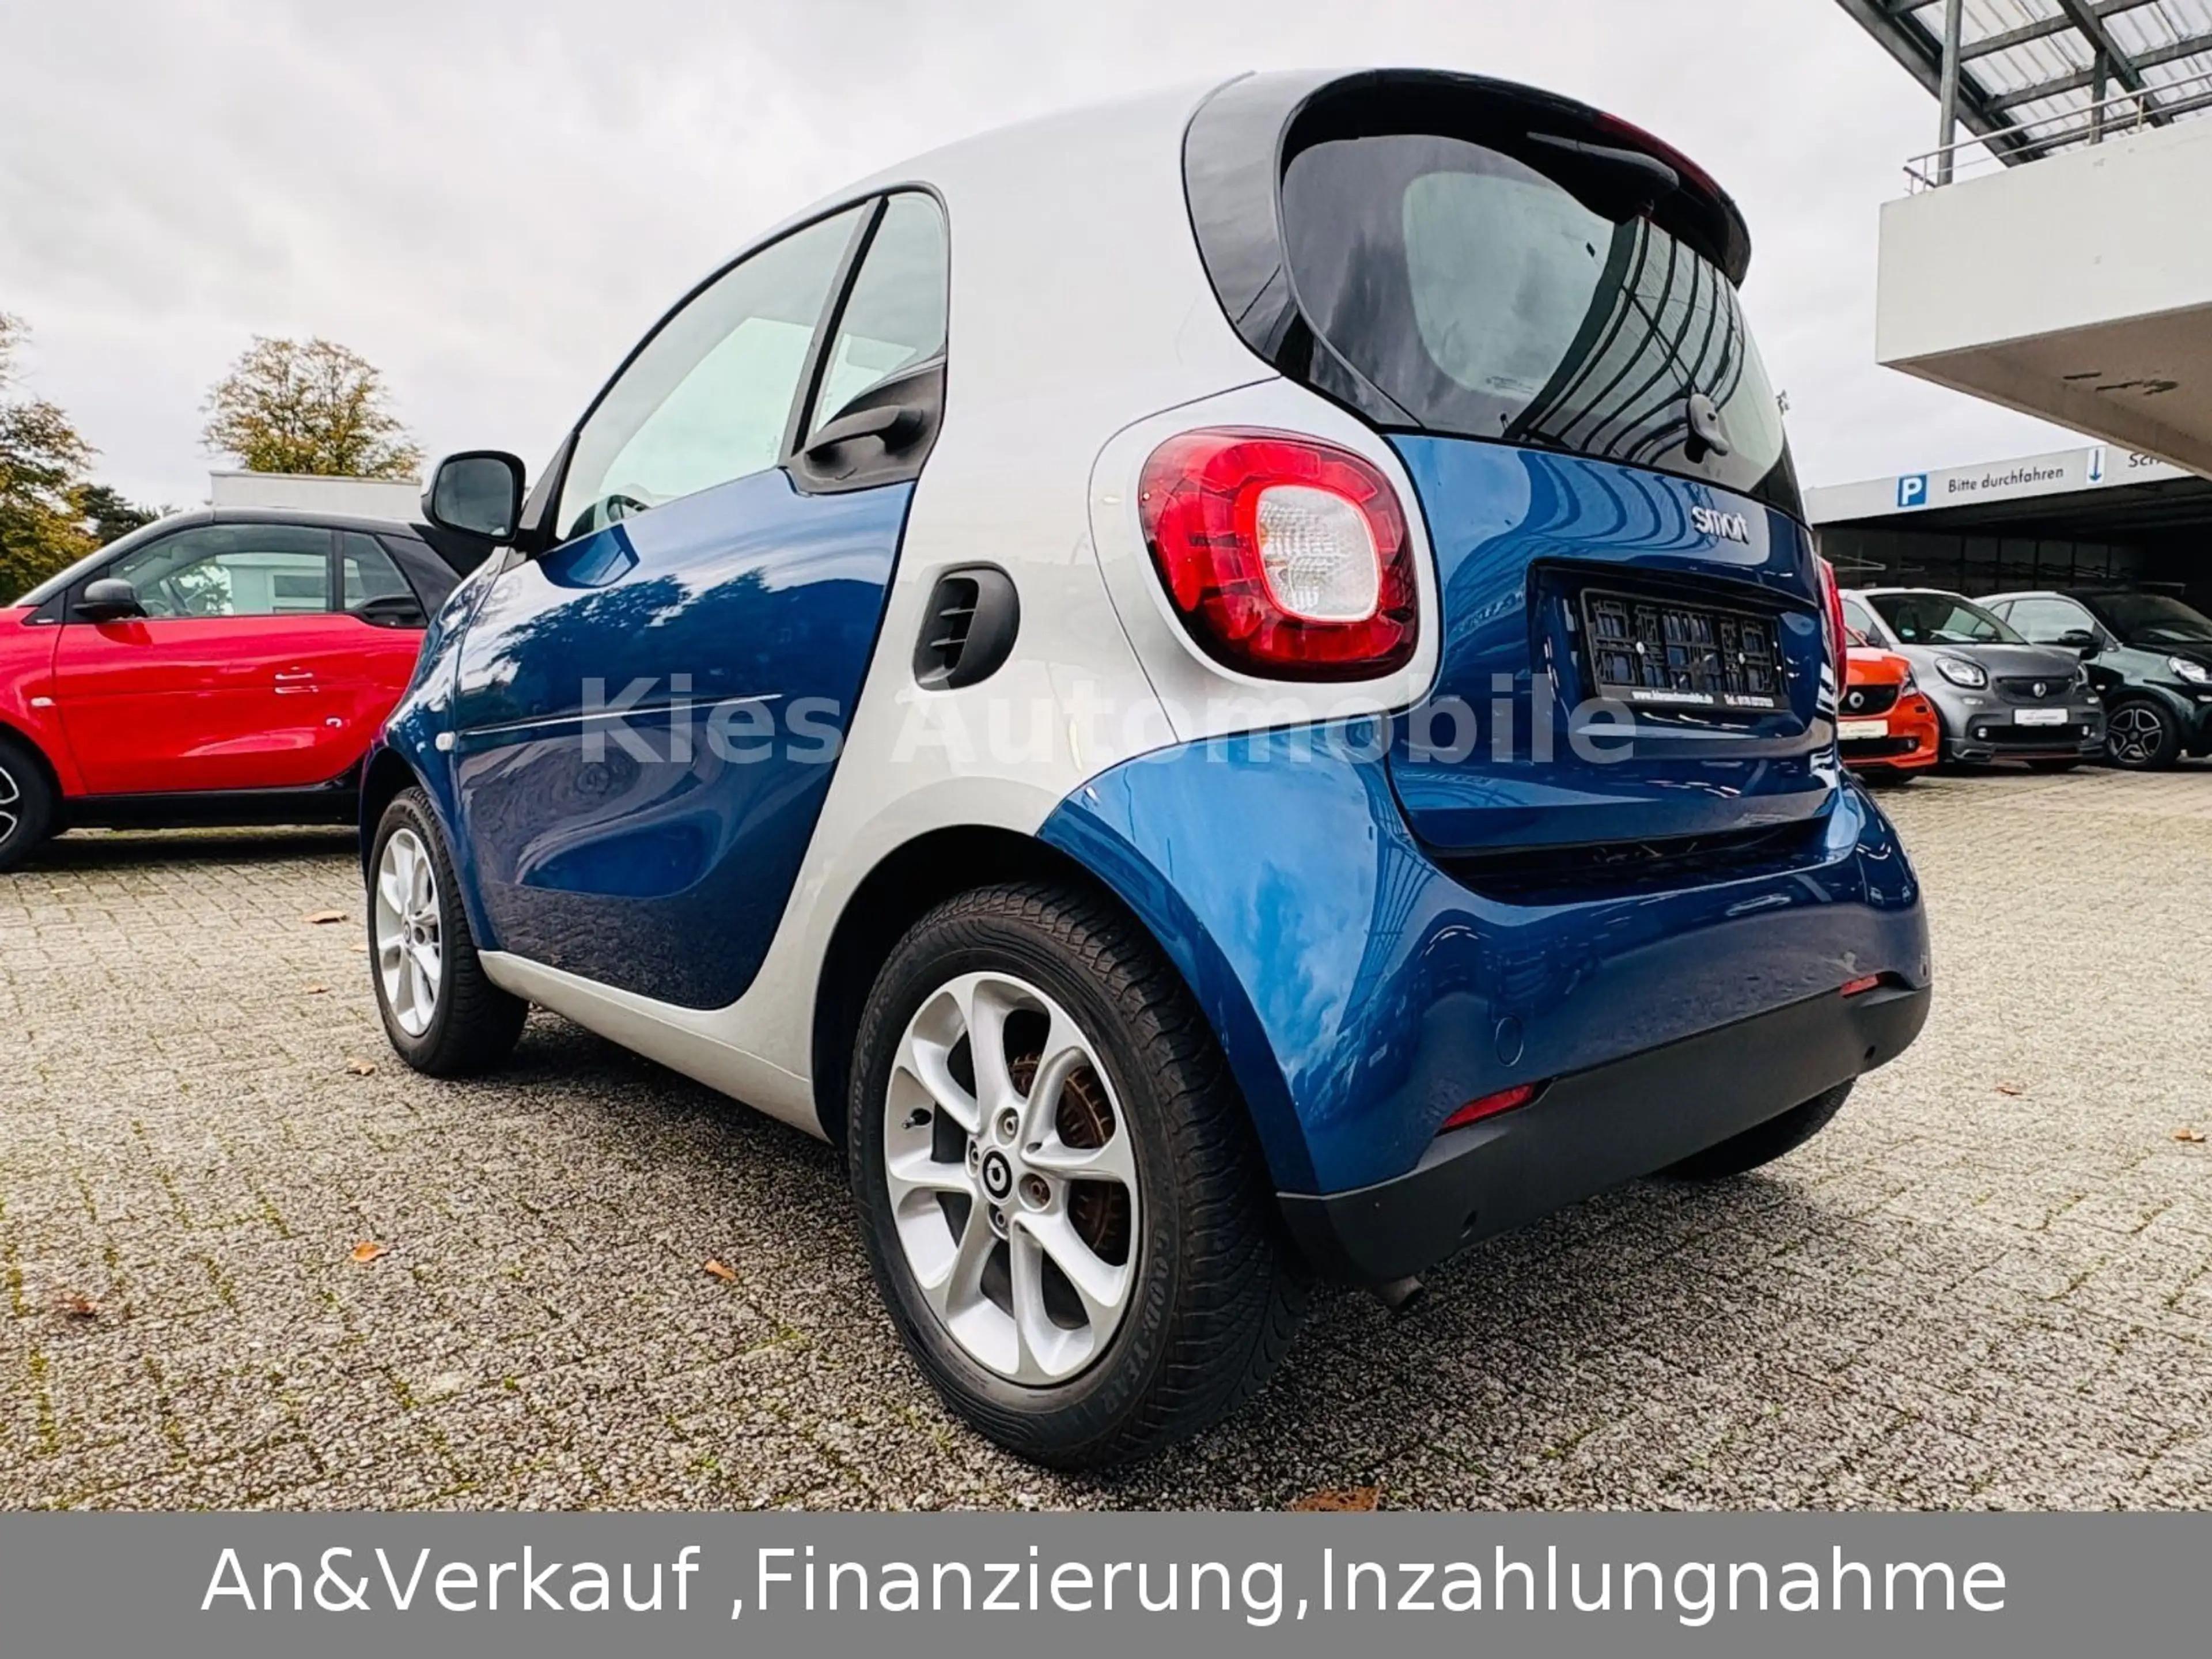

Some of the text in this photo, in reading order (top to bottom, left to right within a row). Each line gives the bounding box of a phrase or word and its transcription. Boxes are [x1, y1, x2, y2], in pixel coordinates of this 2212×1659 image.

[1902, 478, 1922, 505] P
[1949, 467, 2063, 493] Bitte durchfahren
[1692, 506, 1748, 541] smart
